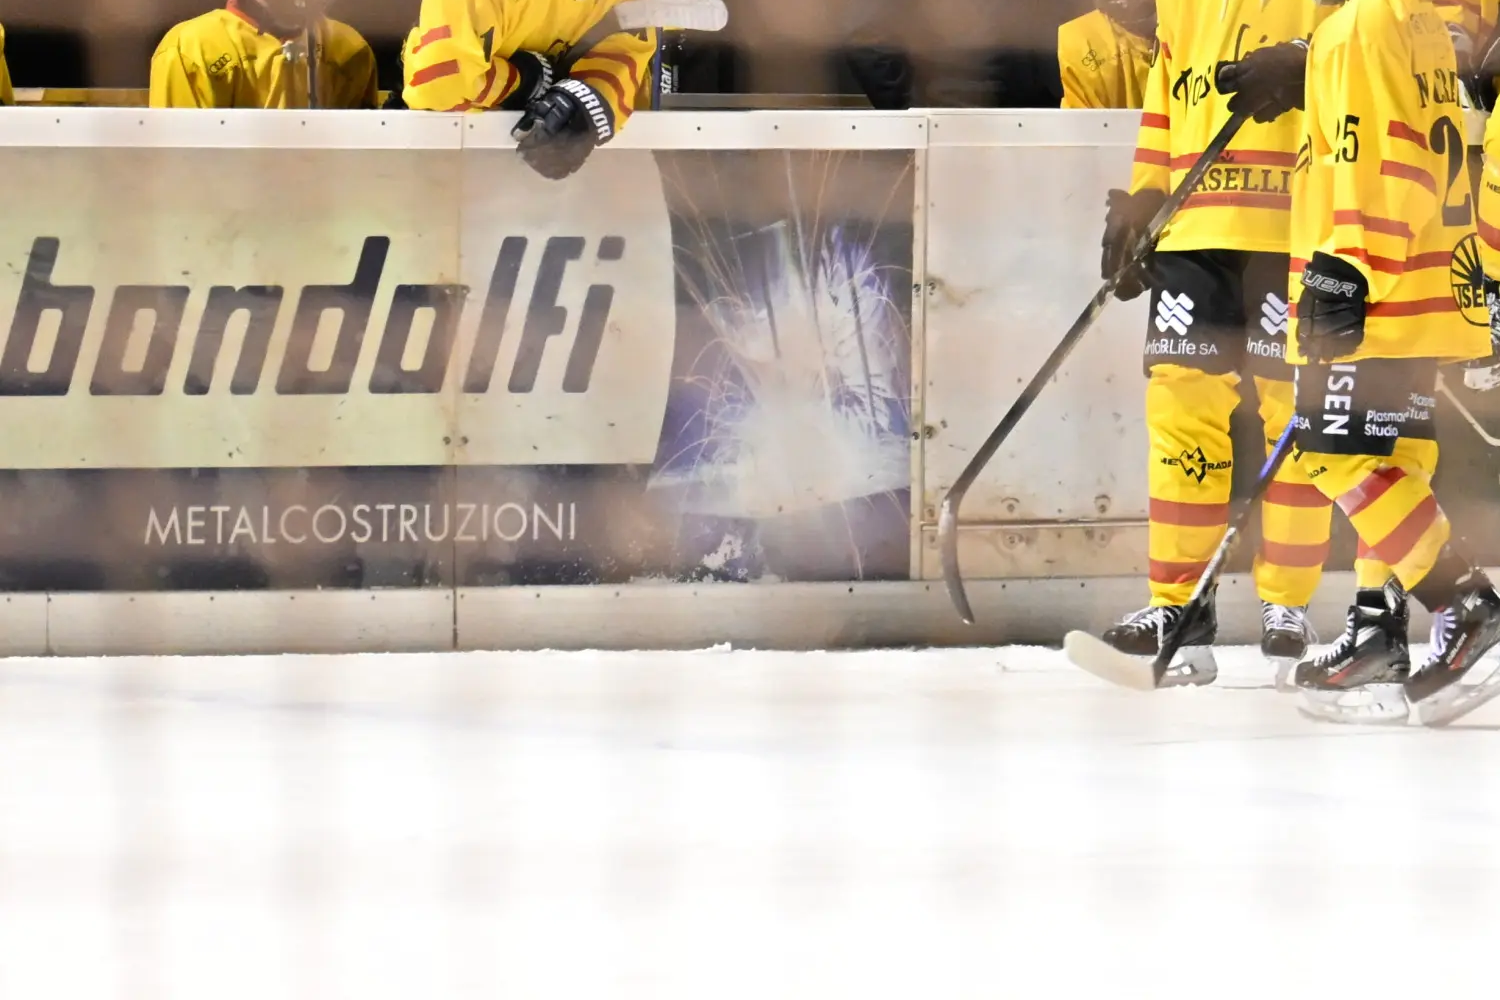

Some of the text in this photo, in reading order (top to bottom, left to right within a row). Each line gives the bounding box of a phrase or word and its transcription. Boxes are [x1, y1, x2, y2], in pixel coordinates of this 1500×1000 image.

[1190, 167, 1291, 193] ASELLI
[0, 236, 626, 396] bondolfi
[145, 503, 577, 545] METALCOSTRUZIONI
